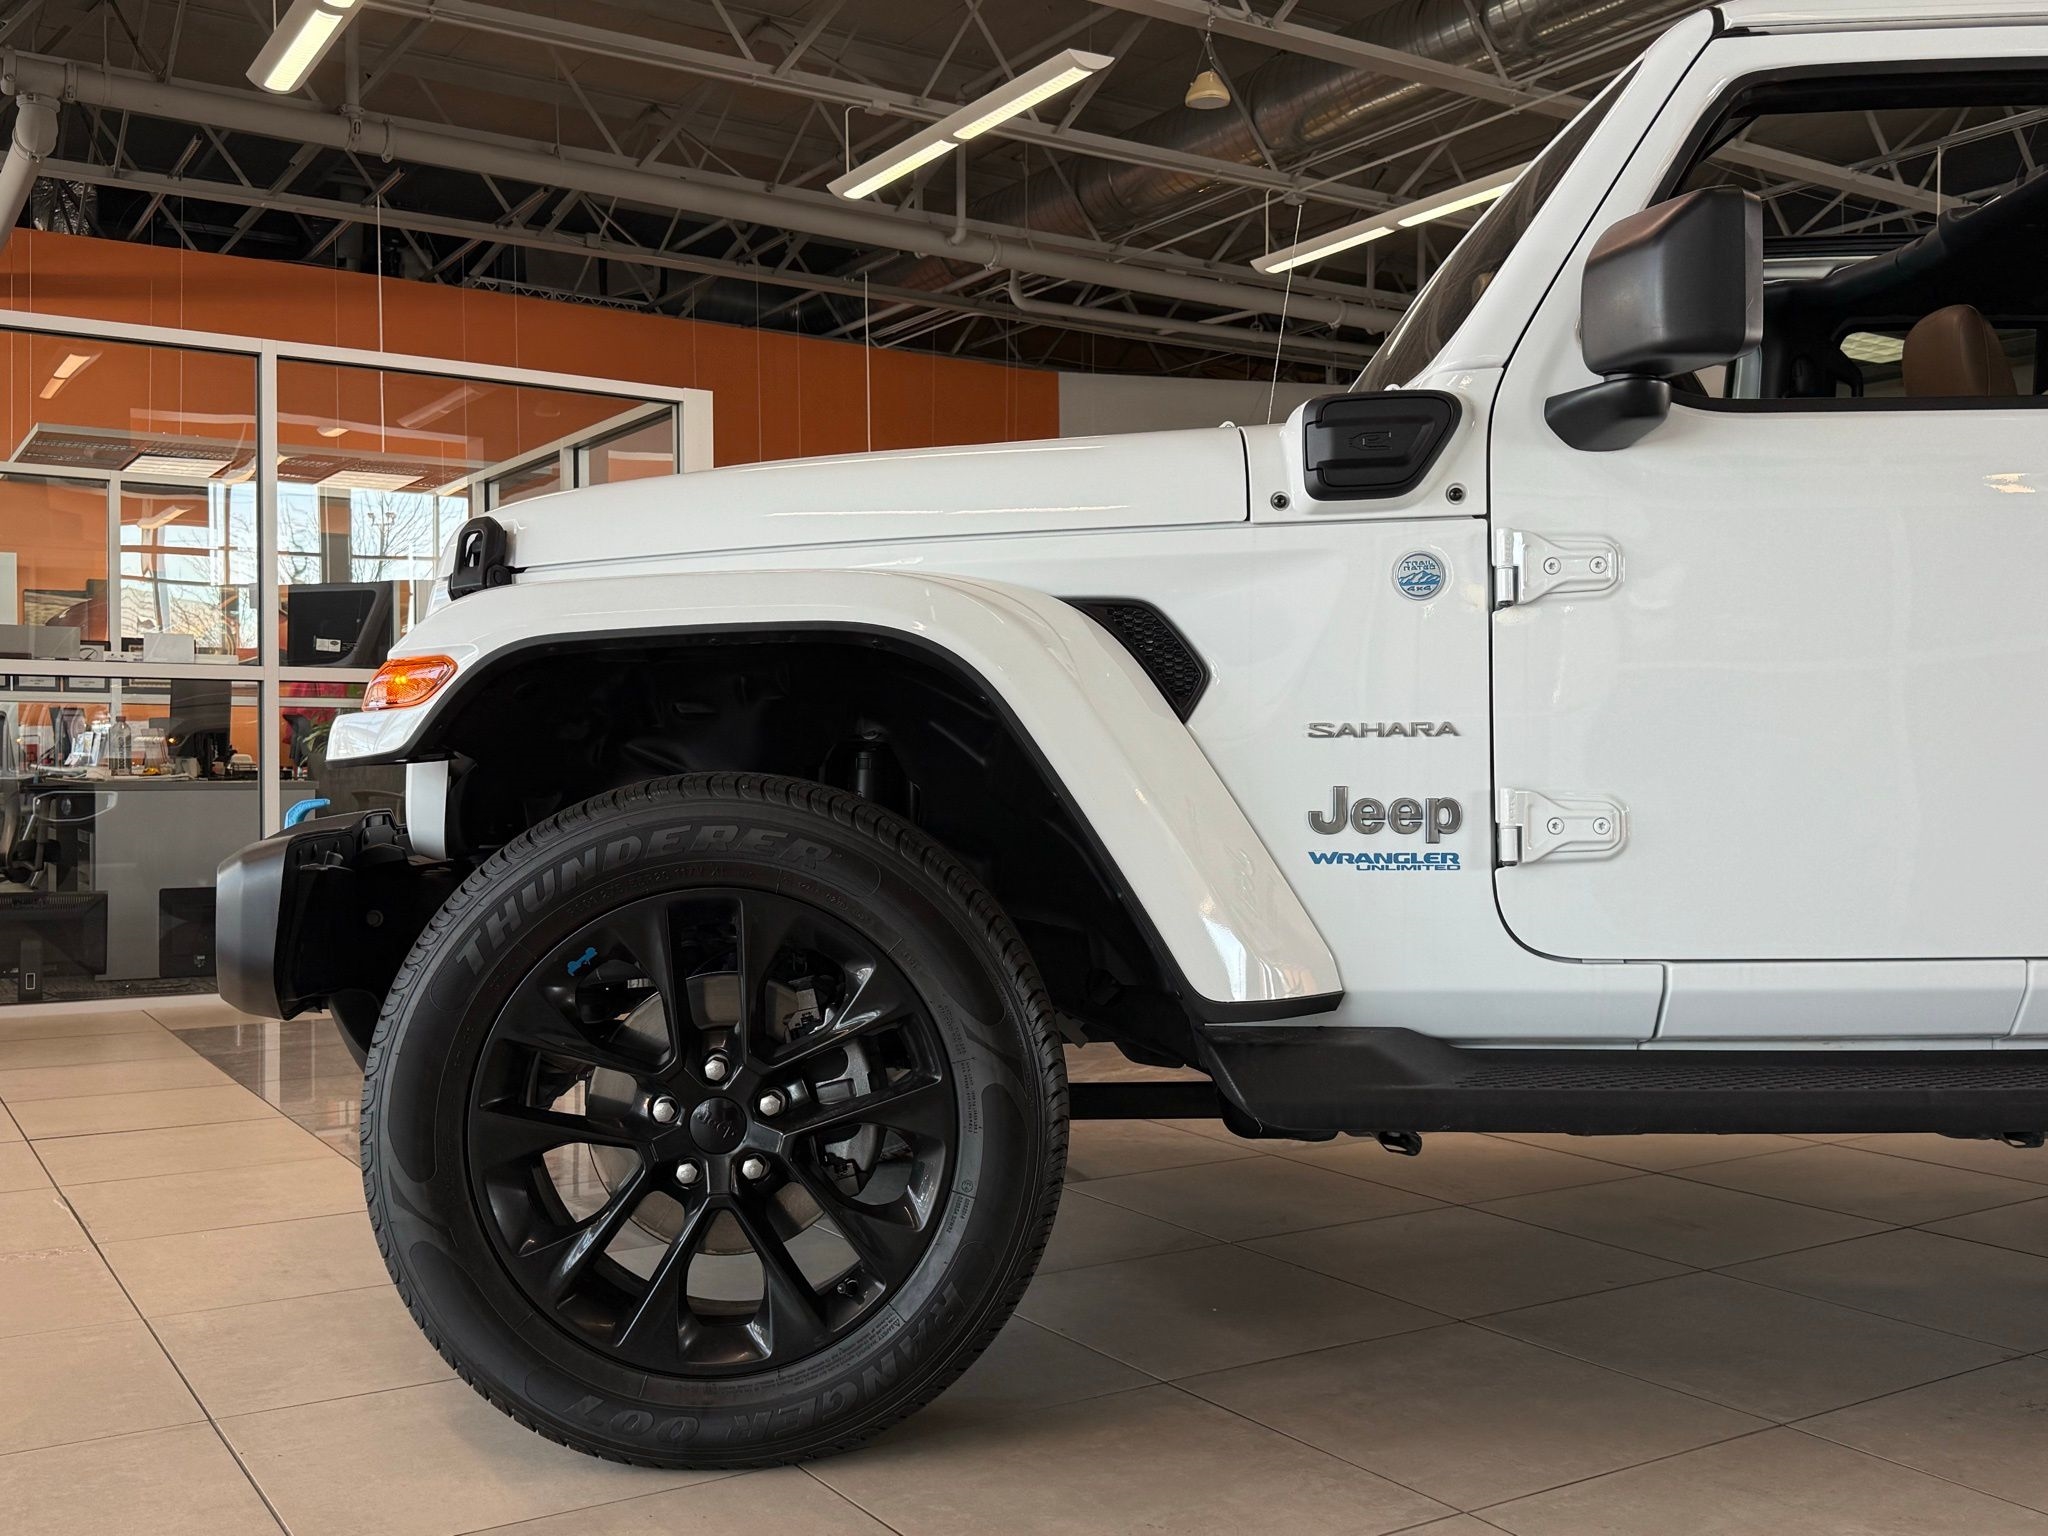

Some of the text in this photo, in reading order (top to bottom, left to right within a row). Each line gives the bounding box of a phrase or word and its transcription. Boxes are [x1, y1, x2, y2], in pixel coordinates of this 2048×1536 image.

[1307, 722, 1461, 738] SAHARA
[1307, 785, 1463, 844] Jeep
[1309, 852, 1460, 865] WRANGLER
[1356, 863, 1461, 871] UNLIMITED
[456, 824, 832, 976] THUNDERER
[726, 1280, 968, 1442] RANGER
[563, 1394, 700, 1445] 007
